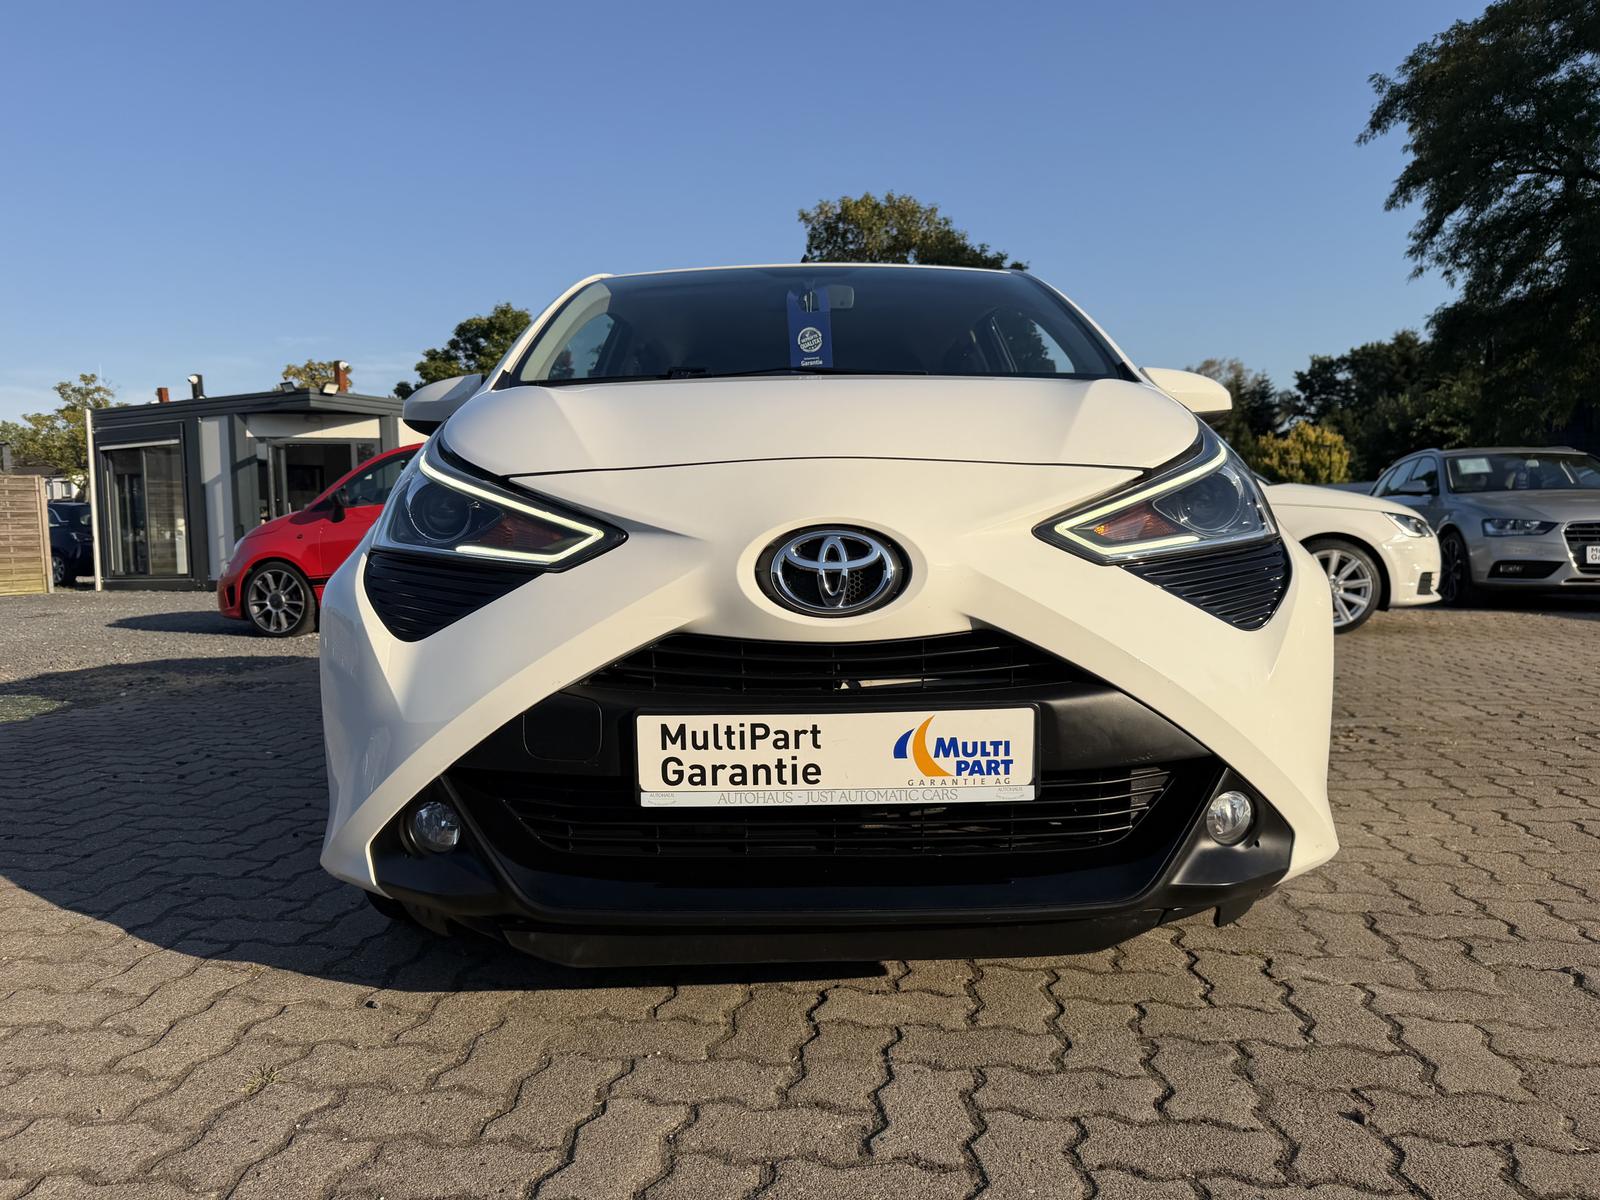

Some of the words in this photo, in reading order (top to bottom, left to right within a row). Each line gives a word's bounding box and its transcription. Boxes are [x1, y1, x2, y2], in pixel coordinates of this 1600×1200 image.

[660, 723, 822, 751] MultiPart
[933, 737, 1011, 758] MULTI
[661, 756, 822, 786] Garantie
[955, 759, 1014, 776] PART
[907, 778, 985, 787] GARANTIE
[995, 777, 1011, 785] AG
[717, 791, 793, 805] AUTOHAUS
[804, 790, 836, 805] JUST
[838, 789, 920, 803] AUTOMATIC
[922, 788, 959, 801] CARS
